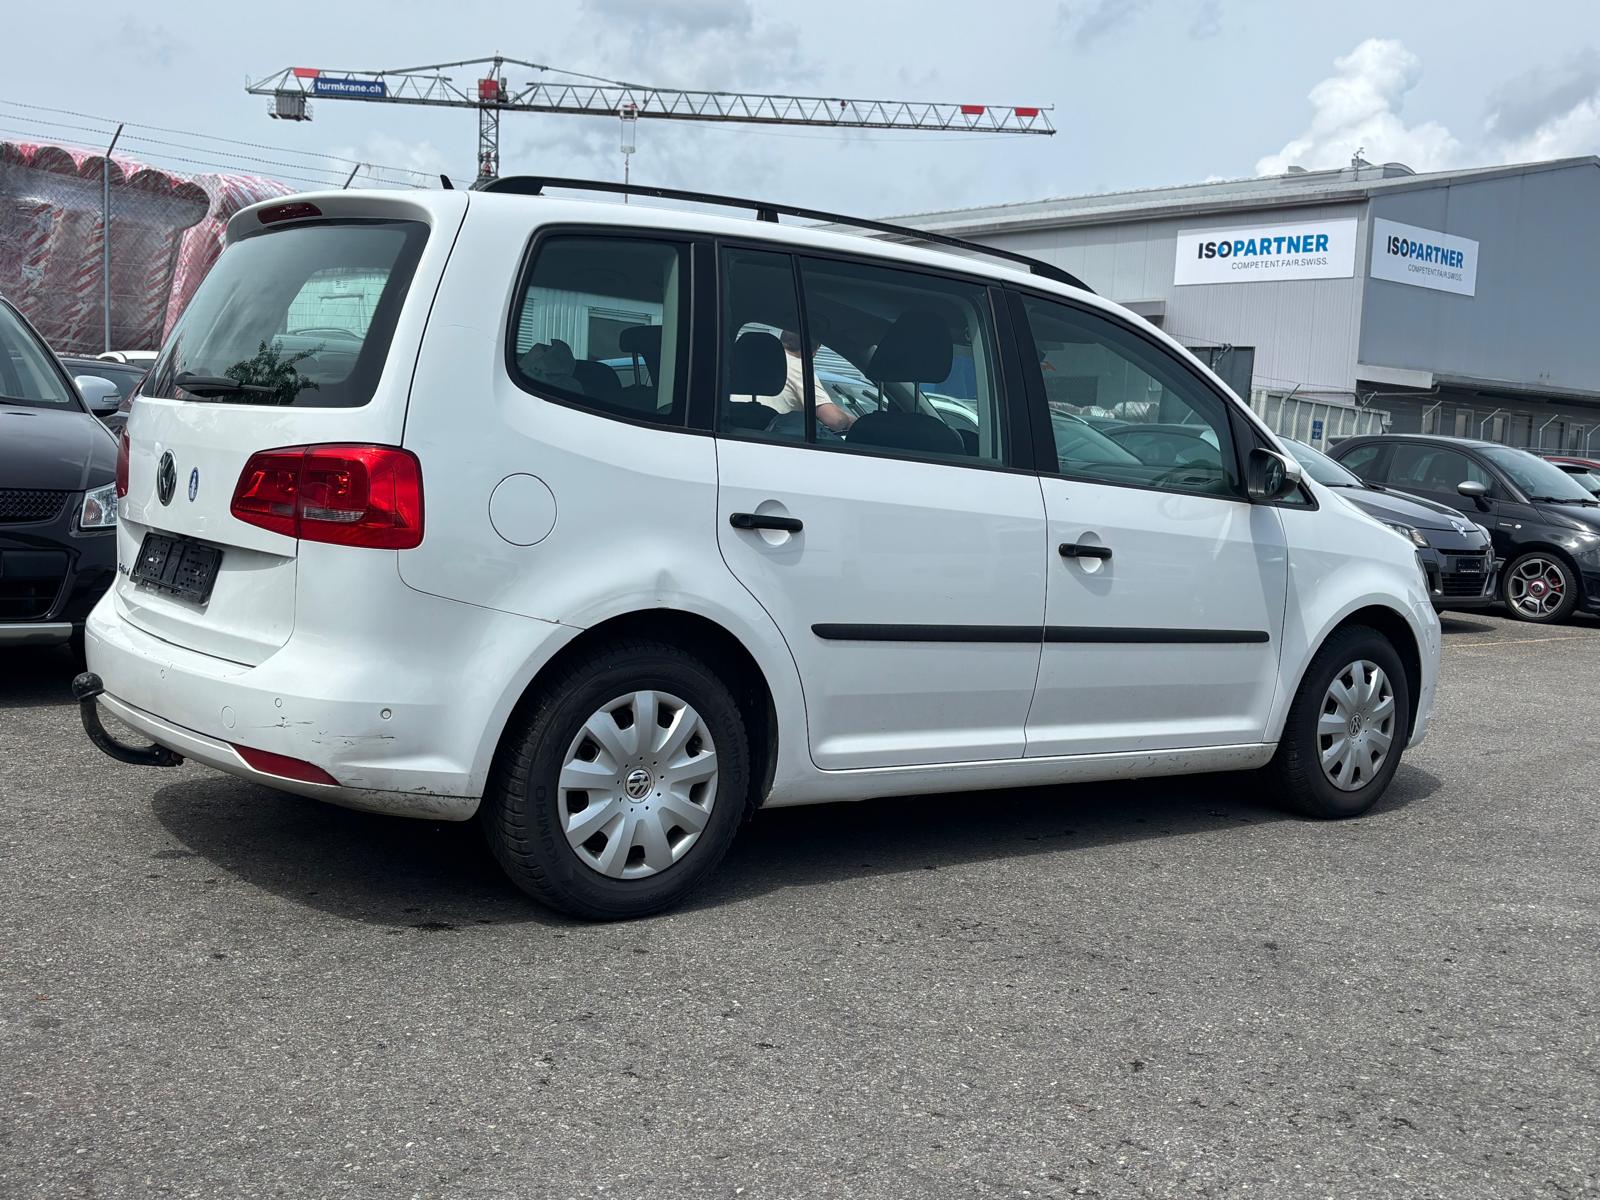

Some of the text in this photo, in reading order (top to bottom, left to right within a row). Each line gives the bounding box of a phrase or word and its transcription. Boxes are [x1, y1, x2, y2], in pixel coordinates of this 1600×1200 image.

[317, 82, 382, 93] turmkrane.ch
[1198, 234, 1329, 259] ISOPARTNER
[1387, 235, 1464, 269] ISOPARTNER
